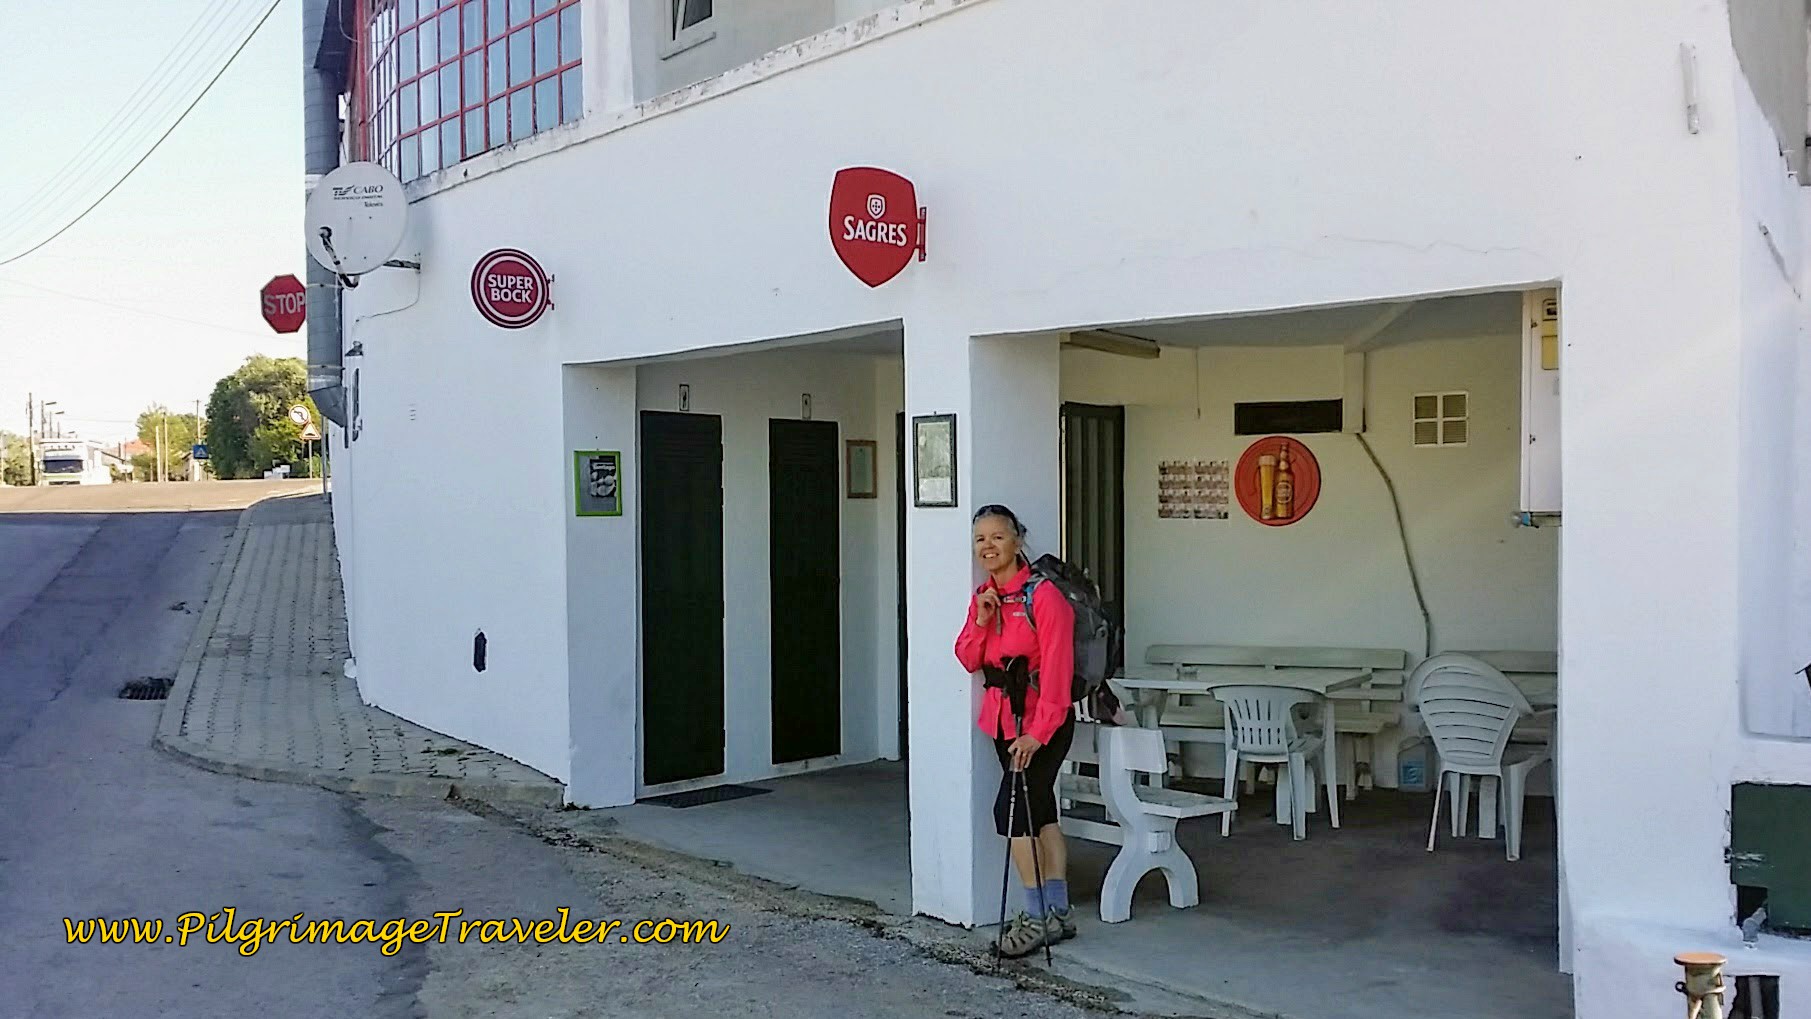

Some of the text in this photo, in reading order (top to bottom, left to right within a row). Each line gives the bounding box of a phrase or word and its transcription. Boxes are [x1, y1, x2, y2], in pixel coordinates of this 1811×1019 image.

[353, 184, 384, 195] CABO
[842, 214, 908, 247] SAGRES
[487, 273, 534, 291] SUPER
[263, 291, 306, 316] STOP
[490, 287, 532, 304] BOCK
